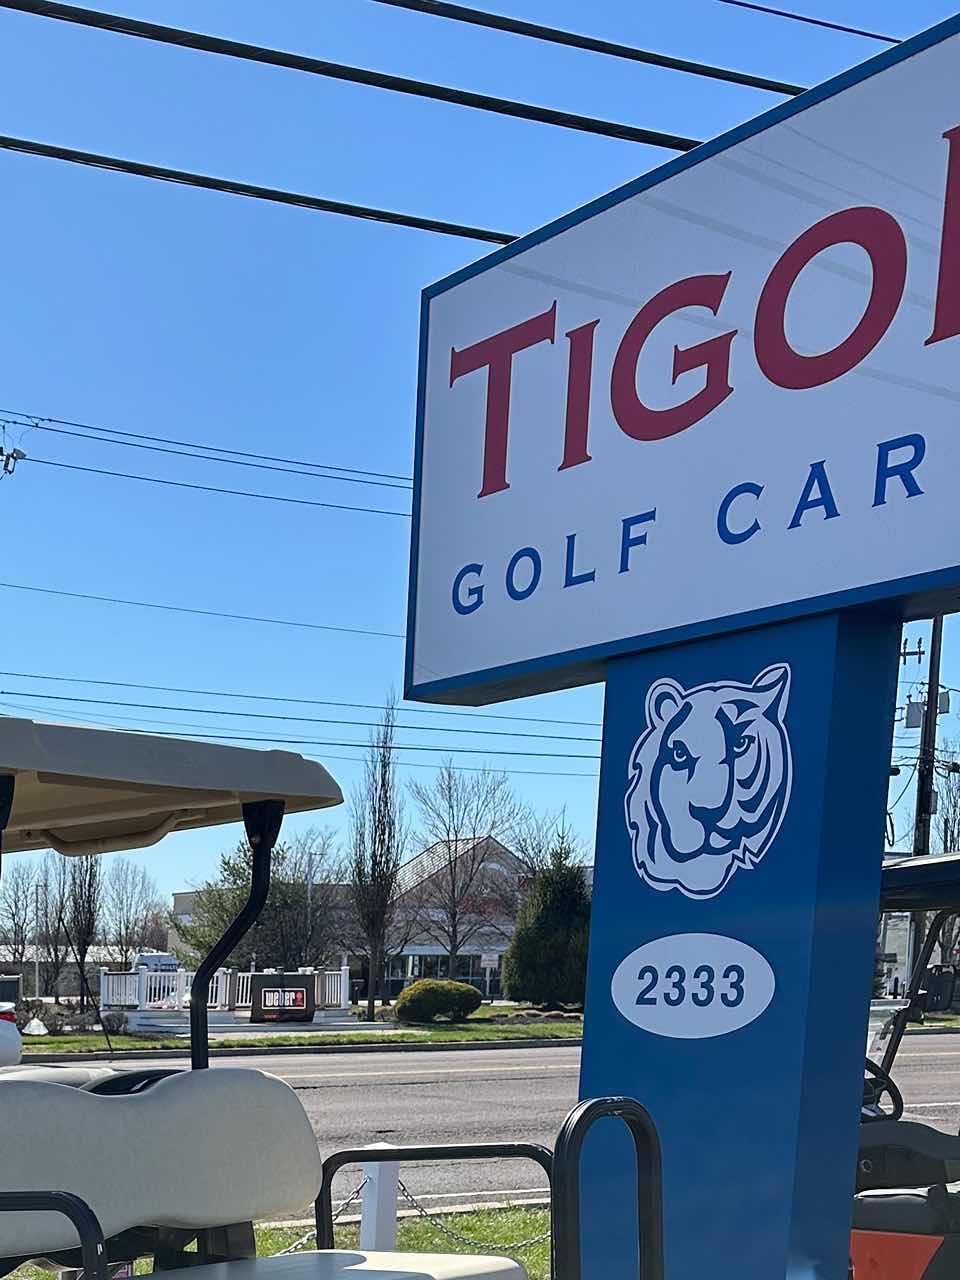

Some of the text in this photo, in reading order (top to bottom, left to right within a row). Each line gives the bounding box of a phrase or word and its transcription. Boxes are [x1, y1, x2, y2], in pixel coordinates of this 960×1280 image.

[451, 507, 657, 616] GOLF
[265, 988, 296, 1007] weber
[635, 964, 746, 1008] 2333
